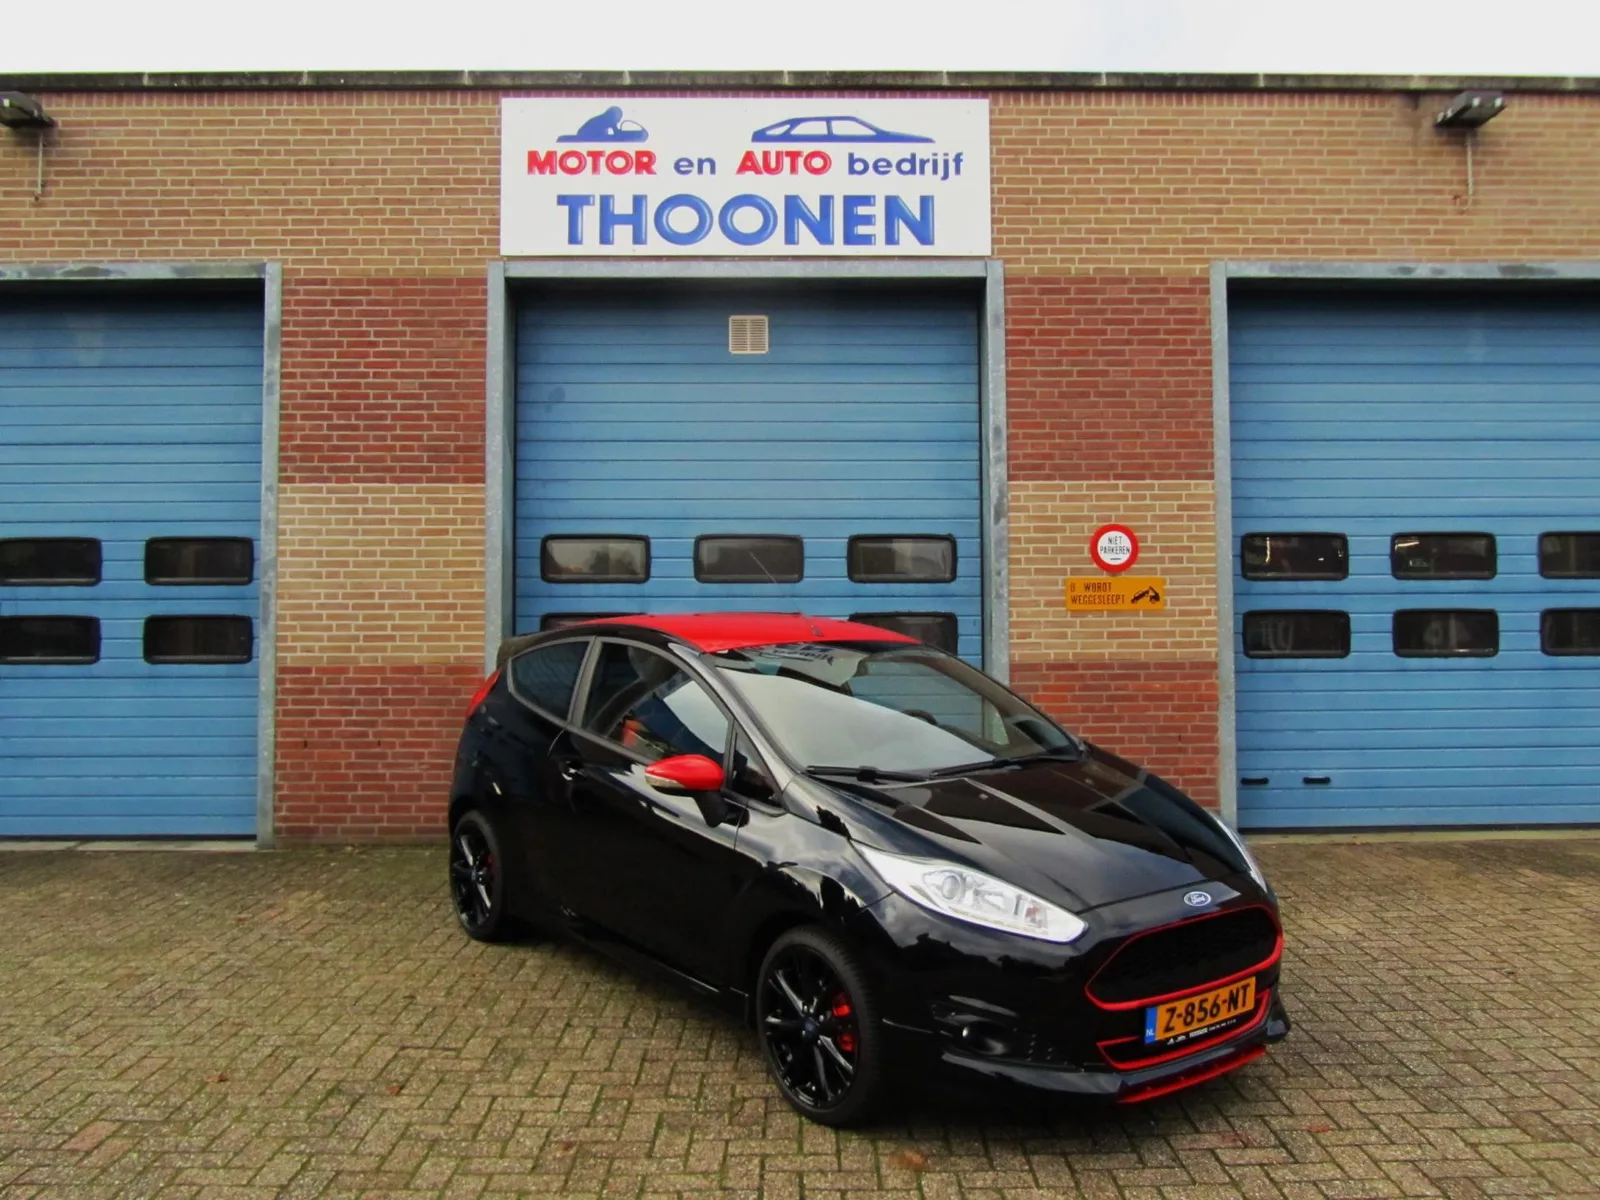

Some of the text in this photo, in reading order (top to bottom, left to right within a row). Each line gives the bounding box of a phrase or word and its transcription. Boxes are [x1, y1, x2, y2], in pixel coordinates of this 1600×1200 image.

[527, 150, 964, 180] MOTOR en AUTO bedrijf
[556, 193, 935, 246] THOONEN
[1107, 536, 1122, 545] NIET
[1100, 546, 1130, 555] PARKEREN
[1070, 582, 1112, 593] U WORDT
[1070, 594, 1125, 605] WEGGESLEEPT
[1163, 984, 1250, 1033] Z-856-NT
[1145, 1028, 1154, 1037] NL
